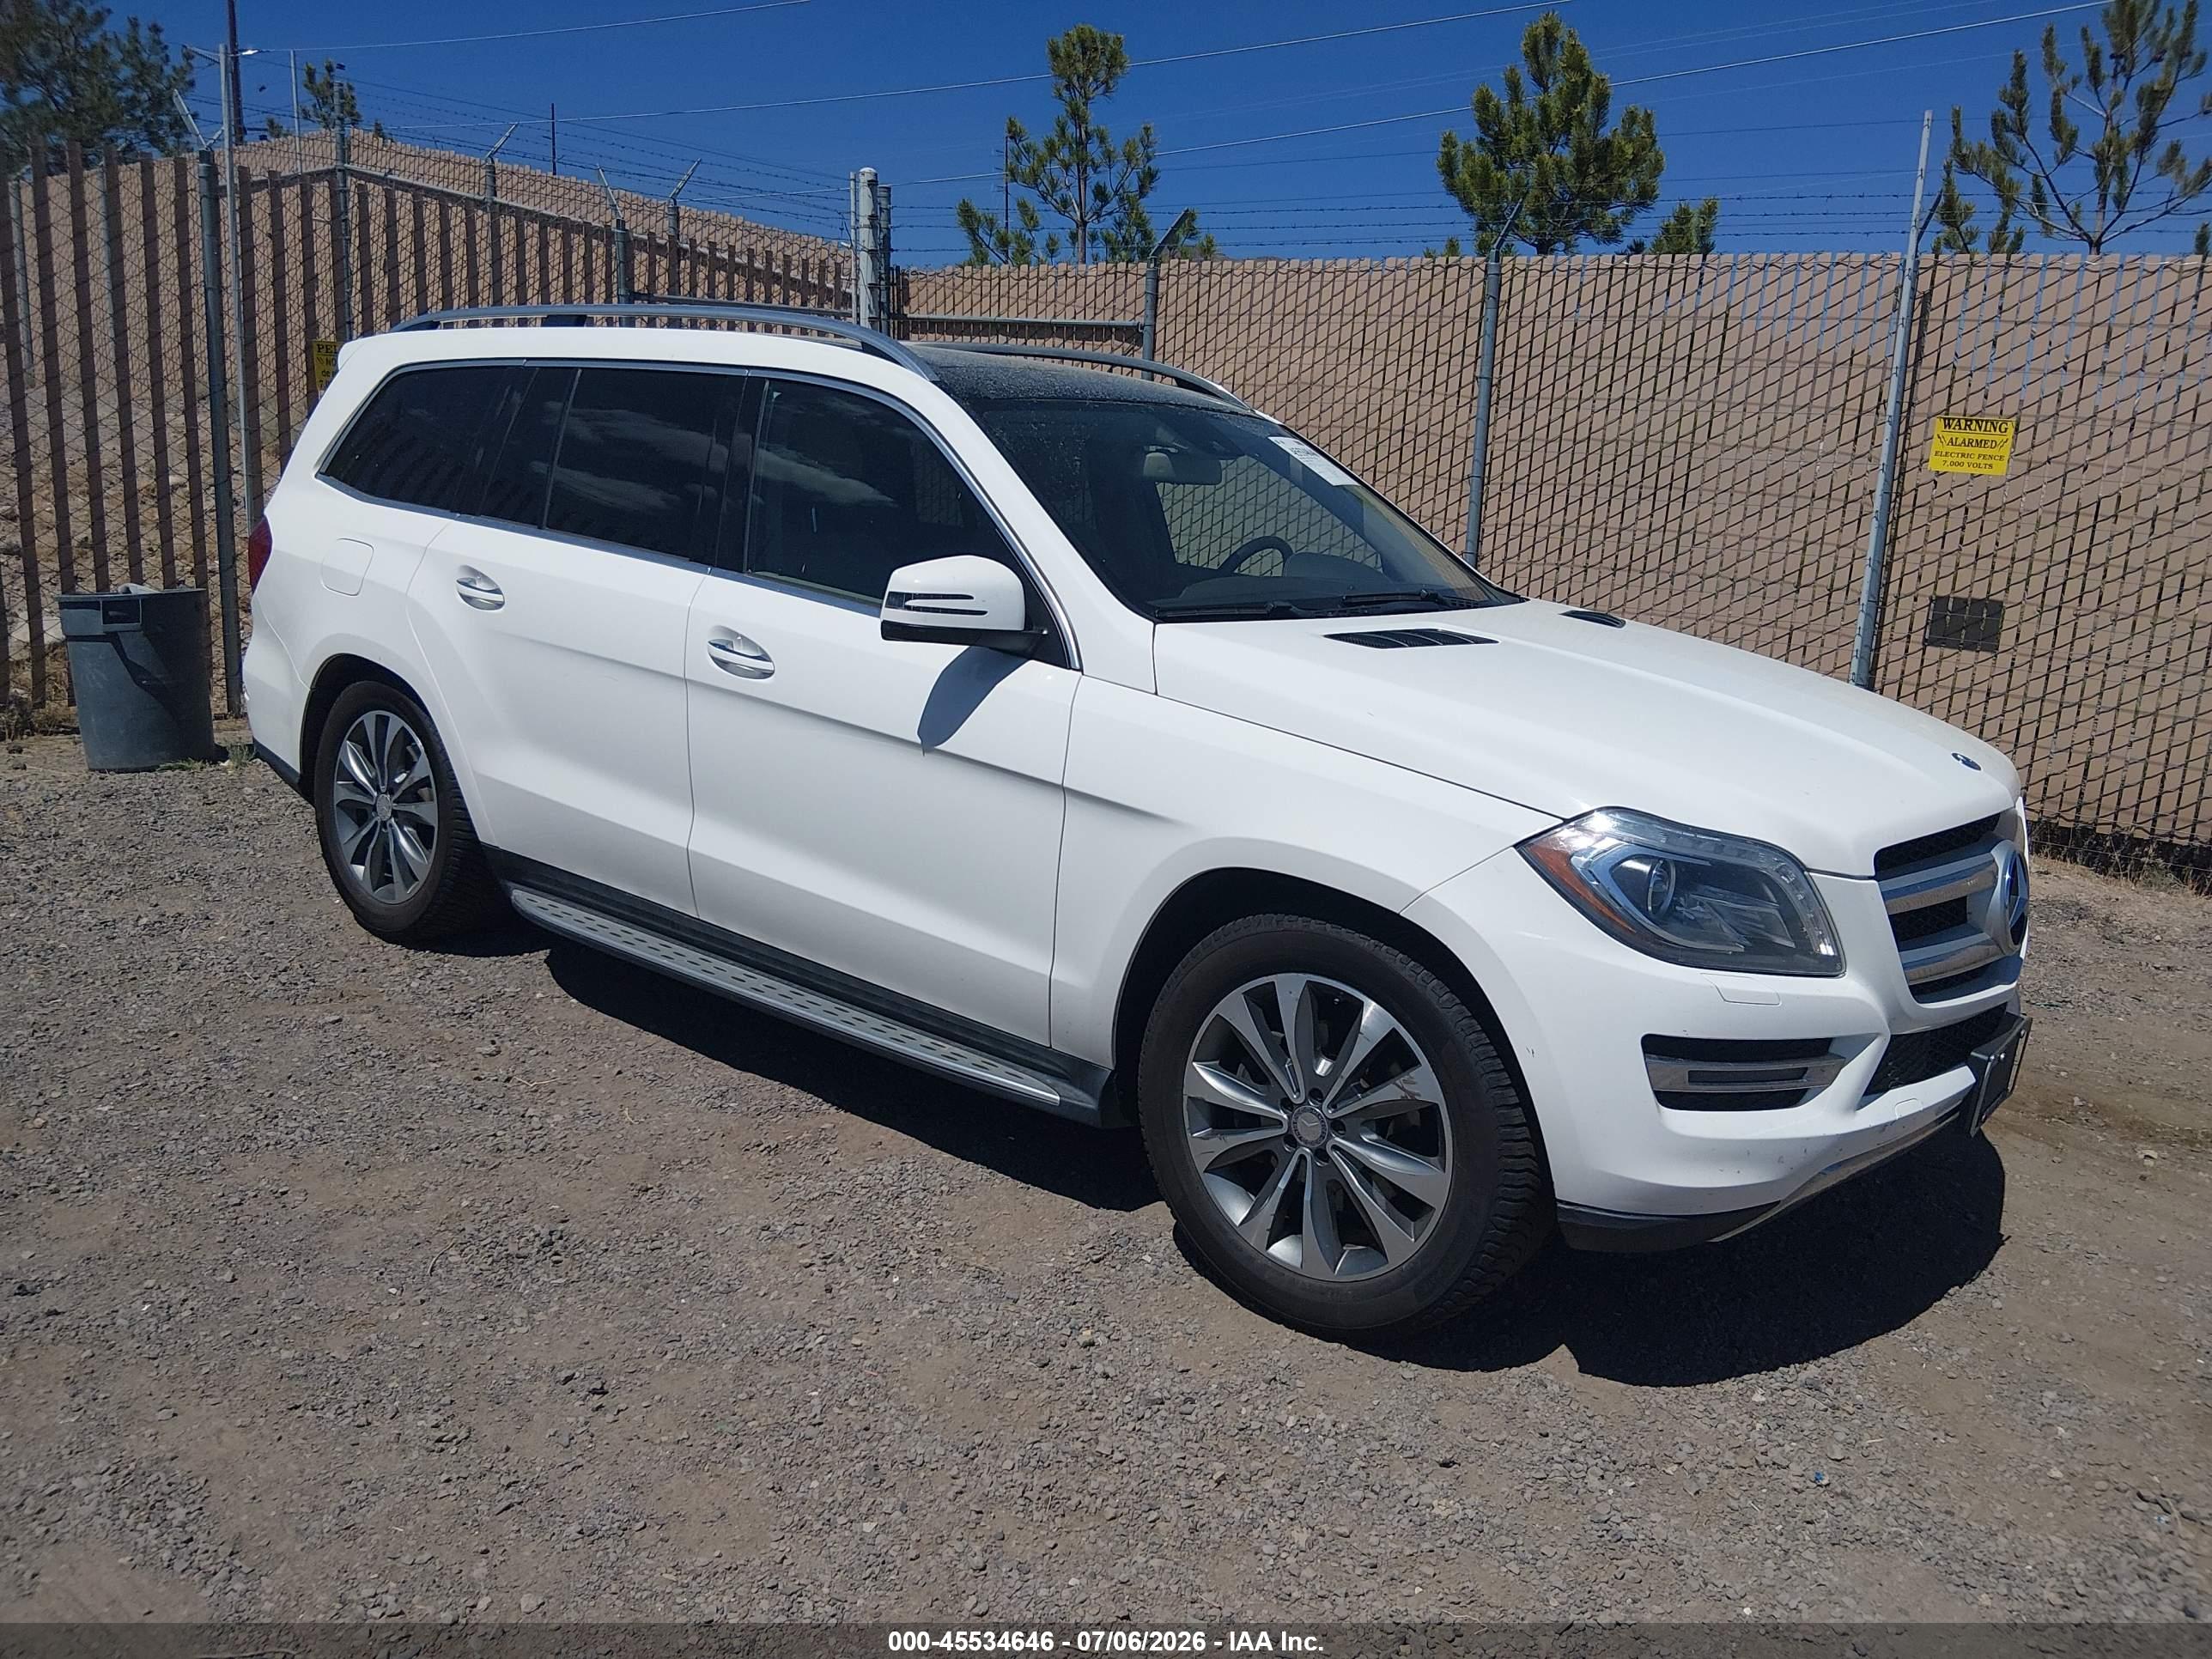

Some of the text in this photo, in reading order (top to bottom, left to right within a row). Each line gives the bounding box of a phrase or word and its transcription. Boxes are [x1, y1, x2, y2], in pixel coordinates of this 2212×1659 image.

[1942, 418, 2008, 434] WARNING
[1947, 436, 1997, 449] ALARMED
[1934, 450, 2005, 462] ELECTRIC FENCE
[1966, 461, 1993, 470] VOLTS
